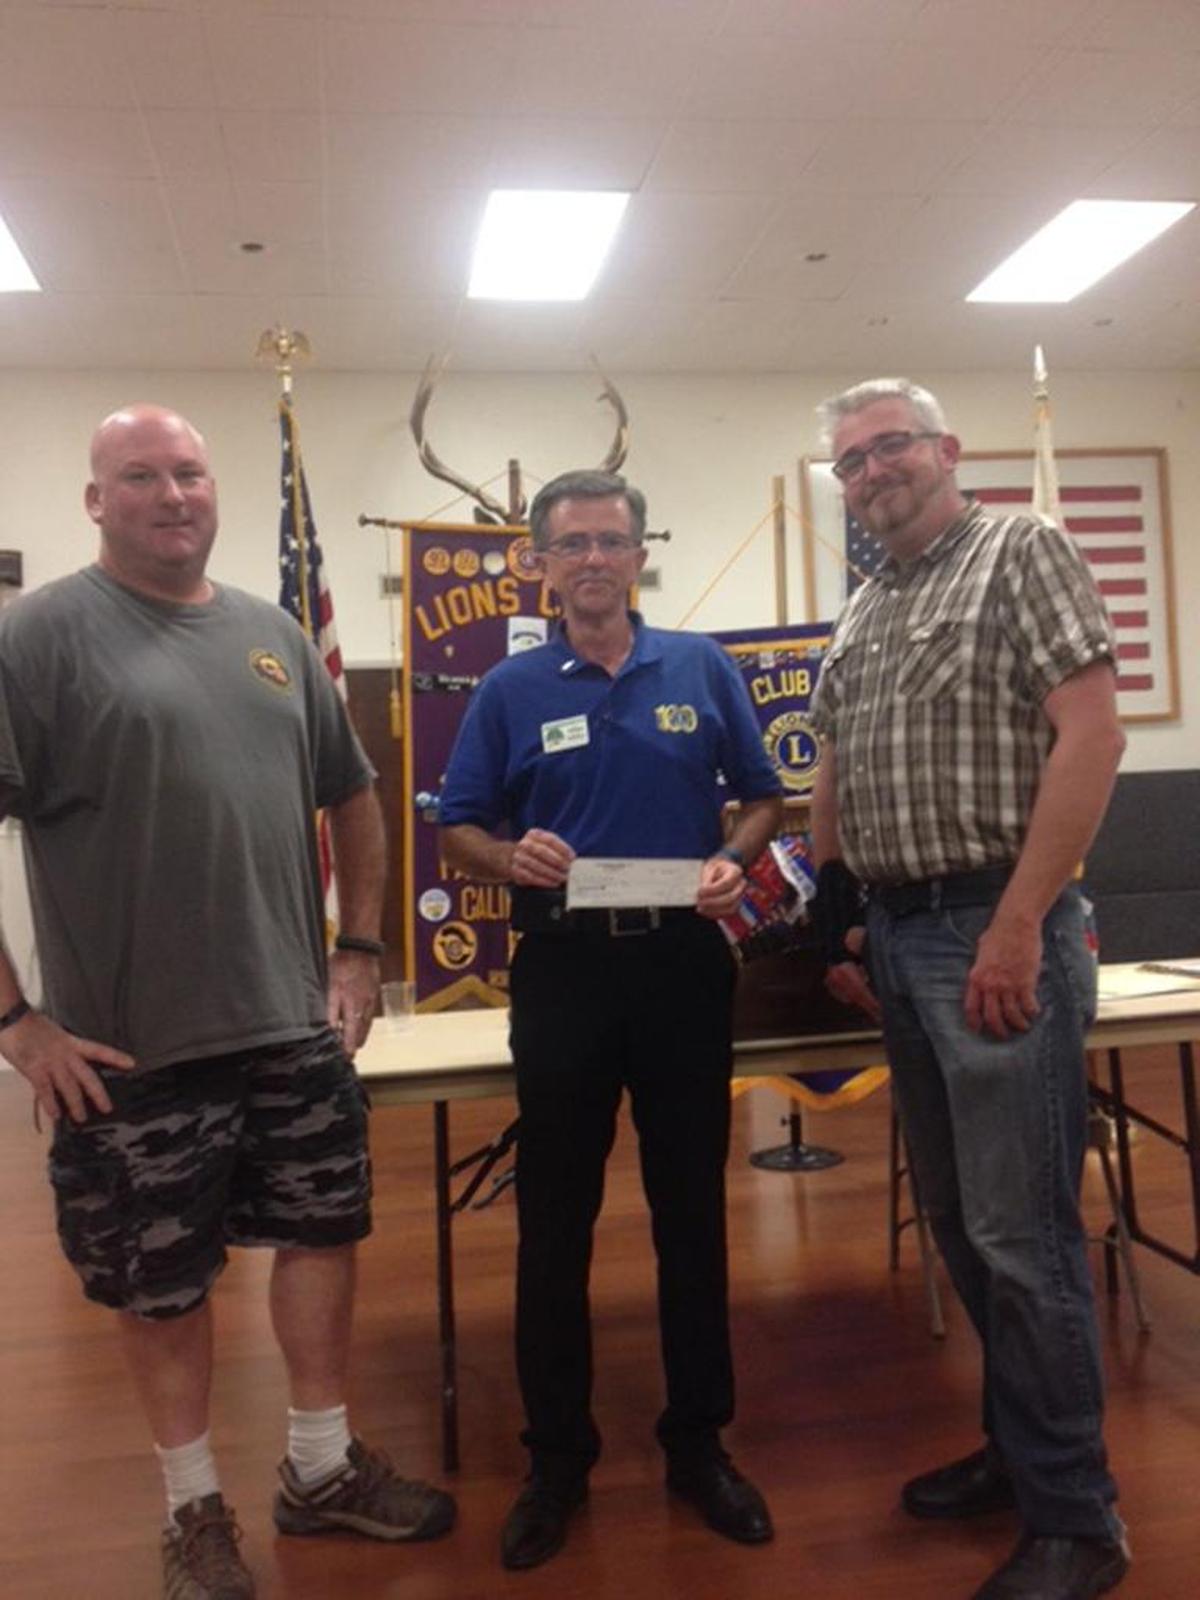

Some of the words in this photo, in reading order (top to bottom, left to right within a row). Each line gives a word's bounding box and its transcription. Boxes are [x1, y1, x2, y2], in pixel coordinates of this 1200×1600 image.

[414, 576, 520, 641] LIONS
[751, 667, 811, 705] CLUB
[654, 703, 698, 734] 100
[786, 734, 811, 765] L
[460, 884, 512, 921] CALI
